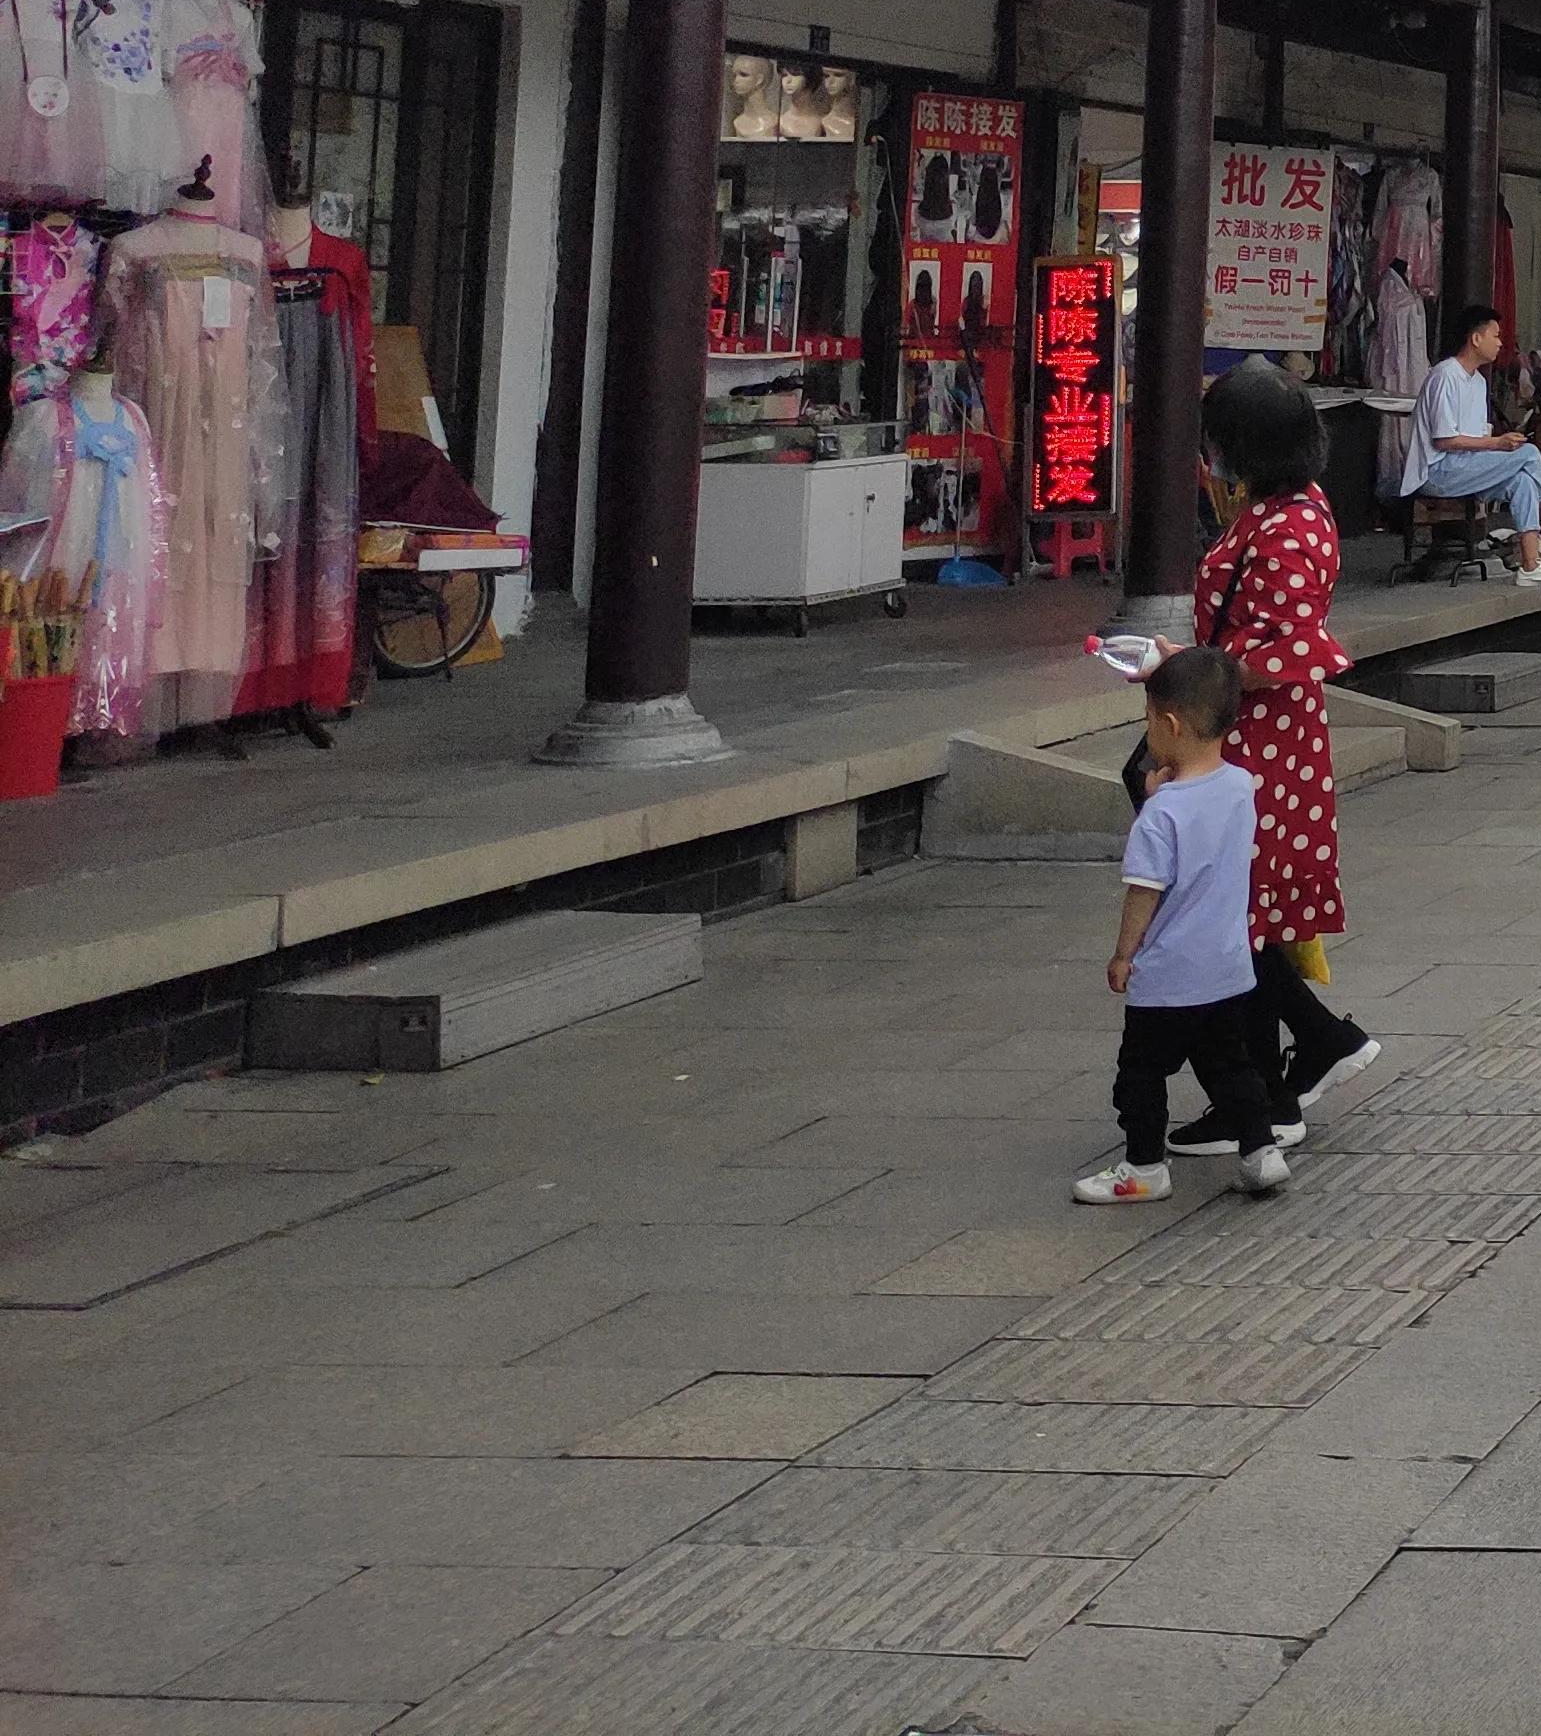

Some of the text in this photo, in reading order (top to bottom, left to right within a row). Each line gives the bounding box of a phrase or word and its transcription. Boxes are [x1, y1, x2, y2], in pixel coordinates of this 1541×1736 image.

[917, 98, 1018, 139] 陈陈接发
[1221, 152, 1325, 211] 批发
[1215, 218, 1323, 243] 太湖淡水珍珠
[1237, 245, 1299, 264] 自产自销
[1214, 265, 1319, 298] 假一罚十
[1044, 267, 1101, 504] 陈陈专业接发
